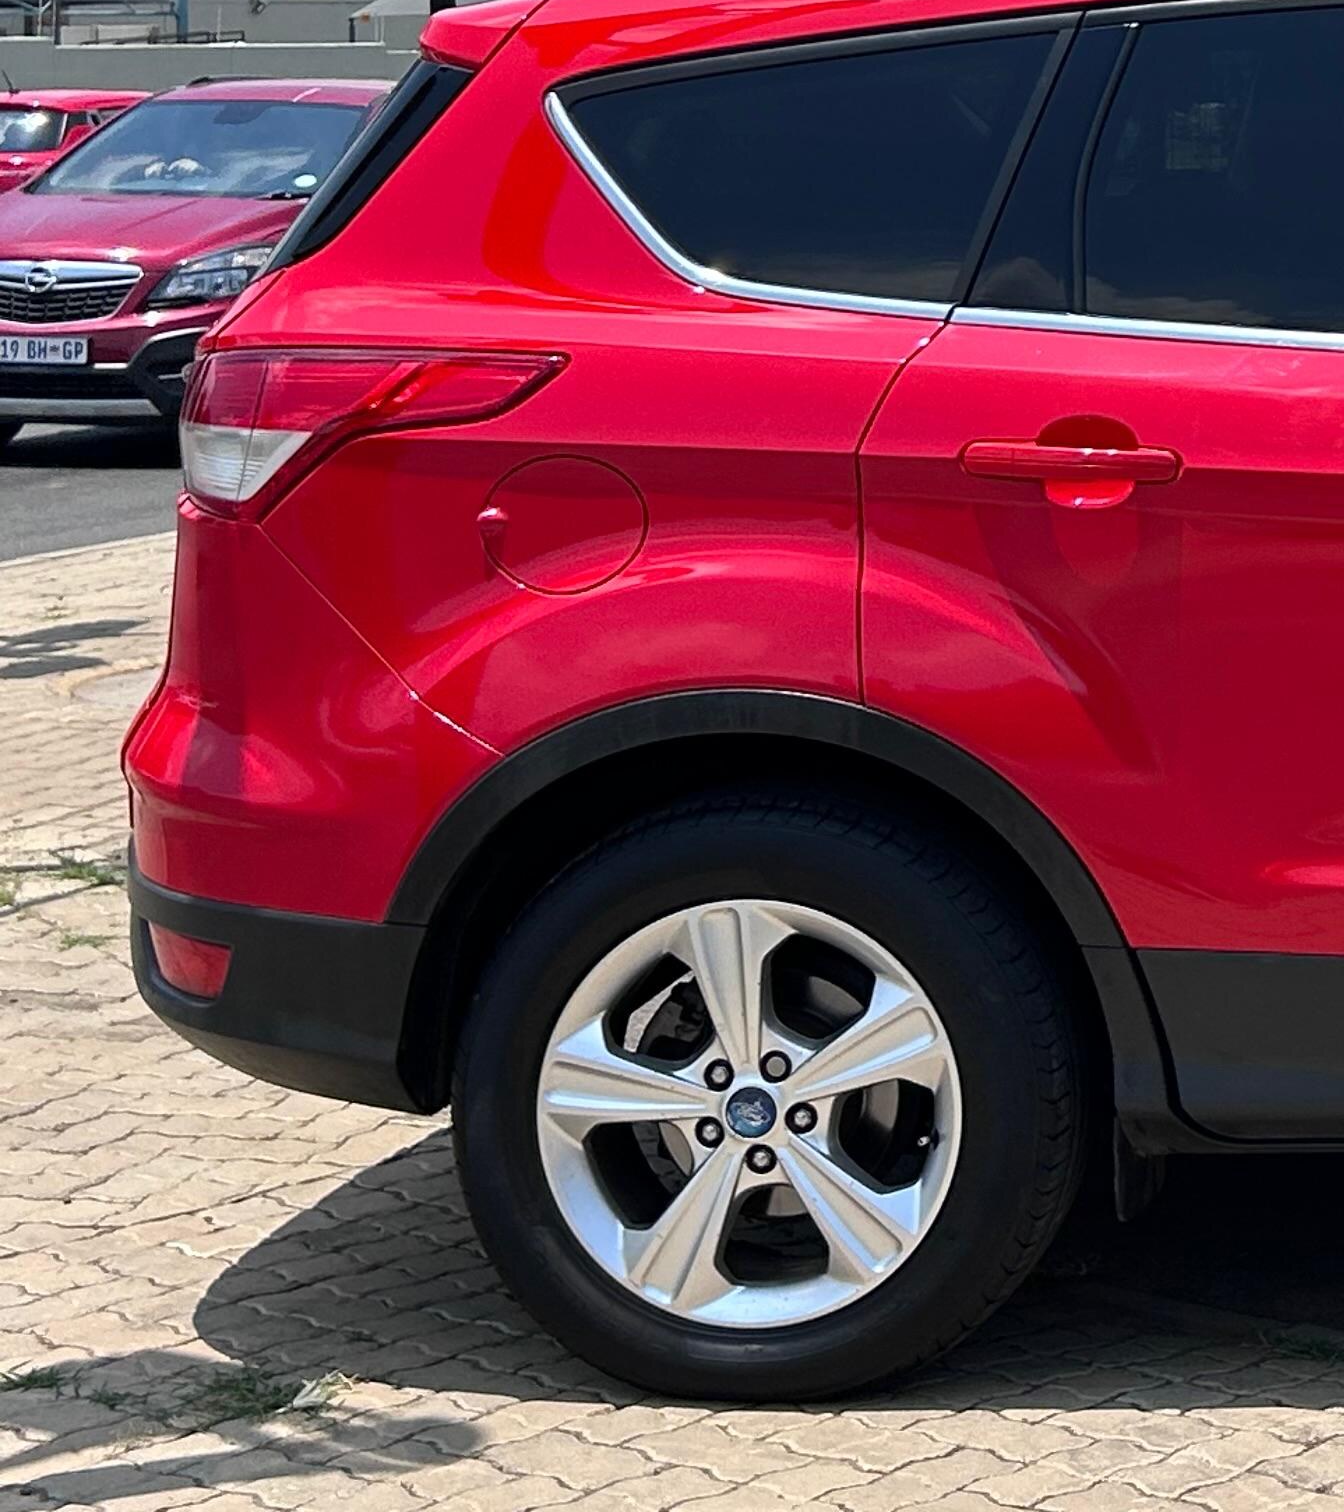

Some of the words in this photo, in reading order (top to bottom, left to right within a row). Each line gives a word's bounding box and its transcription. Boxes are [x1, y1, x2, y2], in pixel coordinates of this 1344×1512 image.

[0, 339, 19, 359] 19
[27, 340, 47, 359] BH
[62, 341, 83, 360] GP
